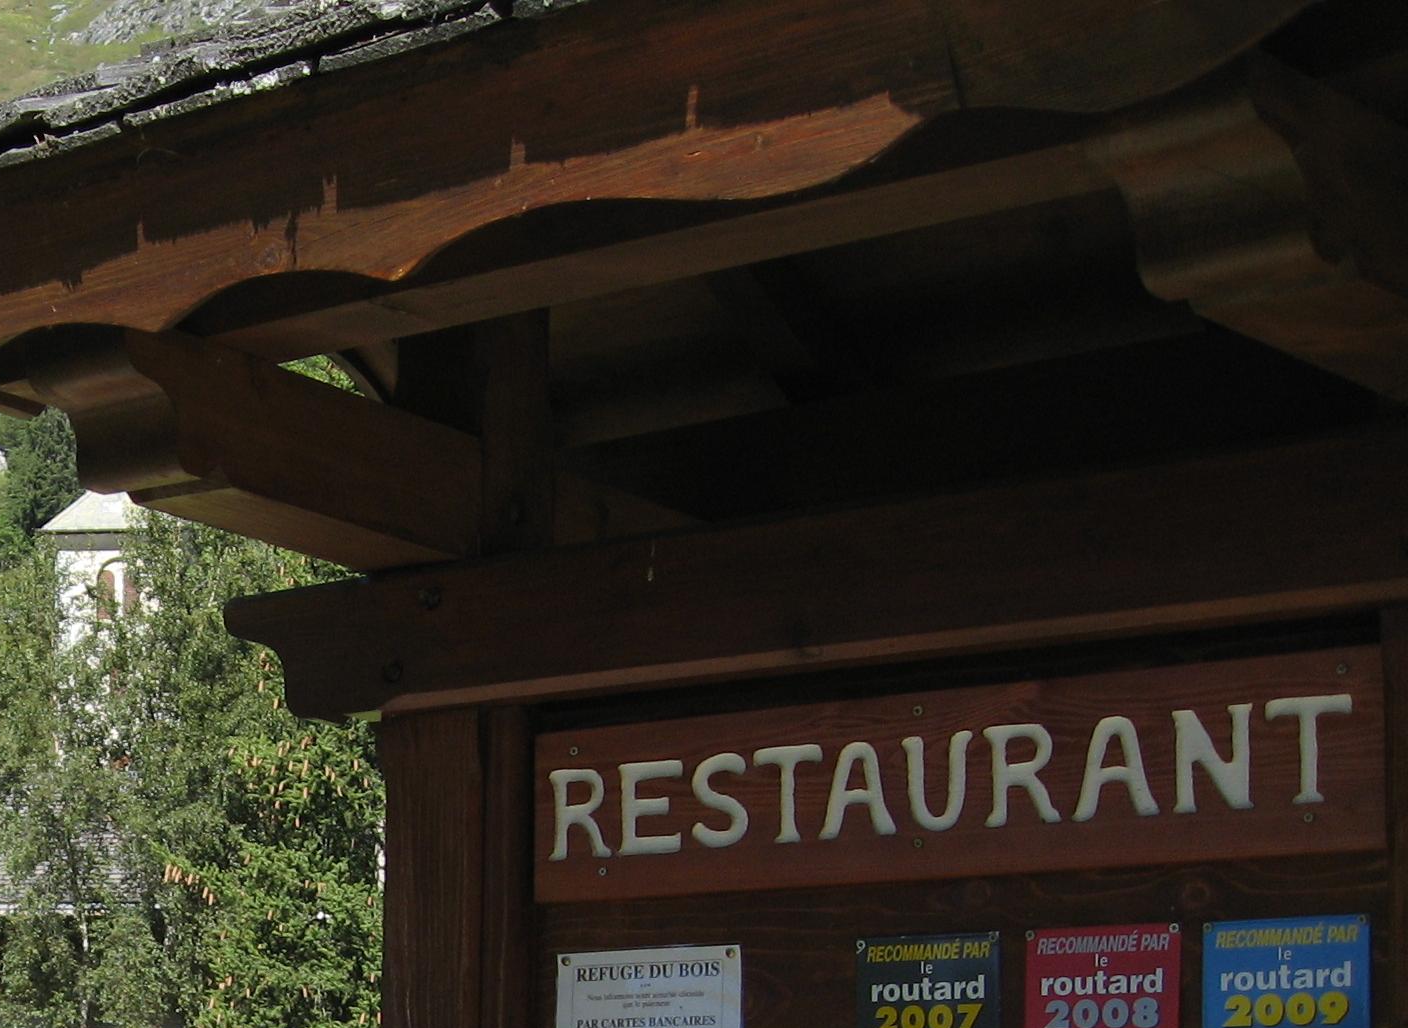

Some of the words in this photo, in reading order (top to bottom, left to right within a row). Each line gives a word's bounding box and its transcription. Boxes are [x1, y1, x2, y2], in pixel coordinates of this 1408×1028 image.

[547, 693, 1354, 862] RESTAURANT
[1037, 929, 1138, 955] RECOMMANDÉ
[1140, 933, 1170, 951] PAR
[1216, 922, 1324, 949] RECOMMANDÉ
[1327, 924, 1359, 944] PAR
[867, 938, 961, 962] RECOMMANDÉ
[962, 941, 991, 959] PAR
[1095, 953, 1108, 968] le
[1278, 946, 1292, 961] le
[576, 964, 643, 982] REFUGE
[649, 963, 673, 979] DU
[679, 961, 721, 978] BOIS
[920, 961, 933, 974] le
[1220, 960, 1352, 992] routard
[871, 974, 985, 1003] routard
[1040, 967, 1164, 996] routard
[576, 1019, 599, 1028] PAR
[601, 1017, 645, 1028] CARTES
[648, 1015, 716, 1027] BANCAIRES
[1221, 991, 1349, 1028] 2009
